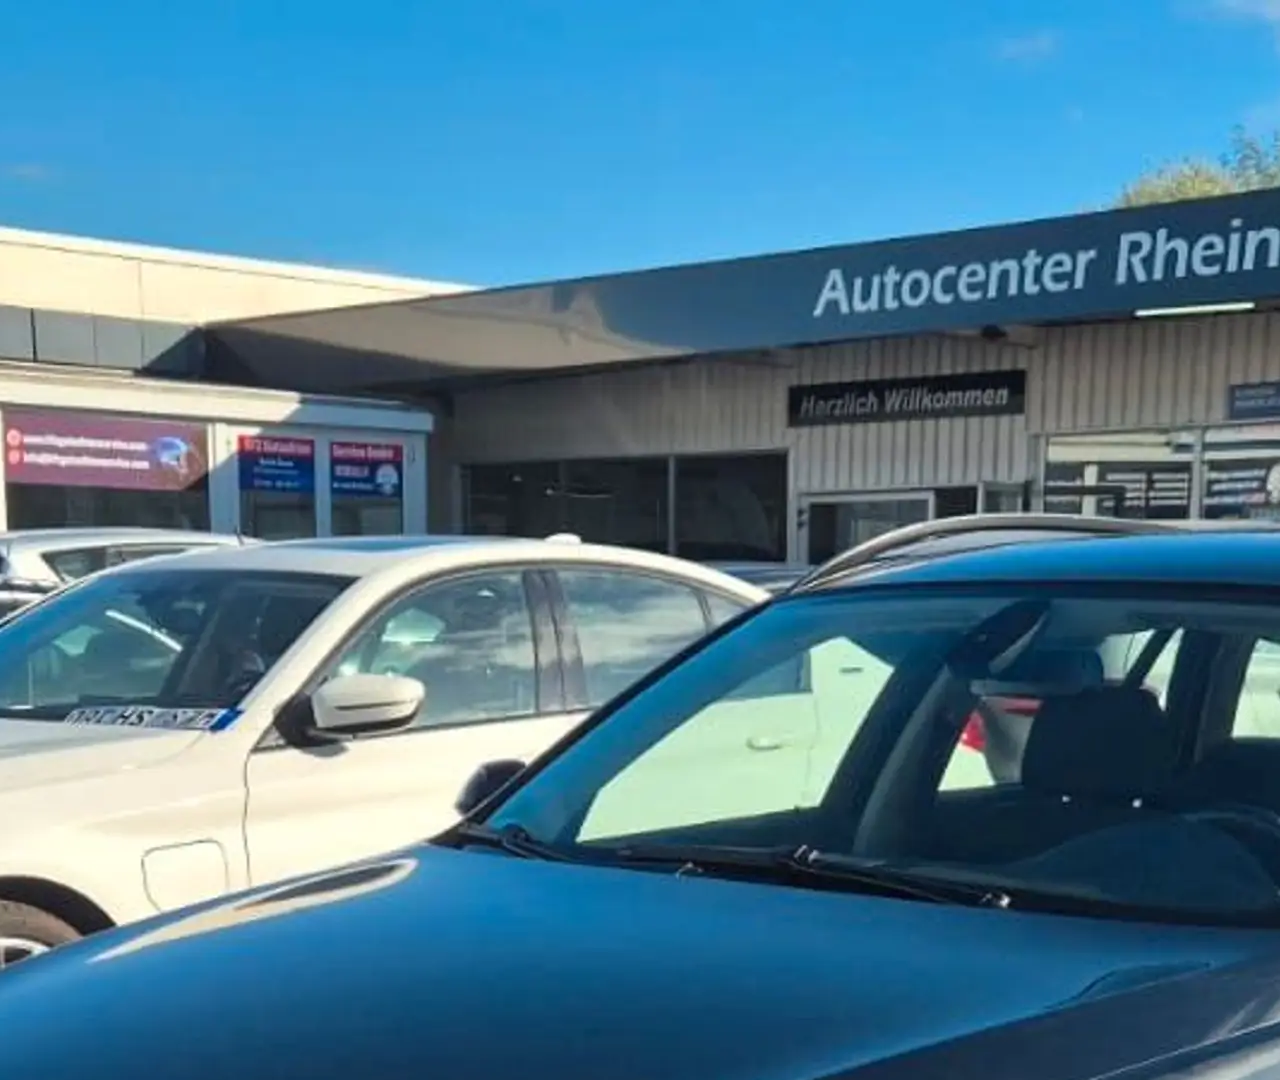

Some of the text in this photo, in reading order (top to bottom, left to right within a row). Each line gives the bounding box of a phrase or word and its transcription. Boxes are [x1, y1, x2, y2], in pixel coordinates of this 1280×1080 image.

[812, 246, 1097, 318] Autocenter
[800, 383, 1010, 417] Herzlich Willkommen
